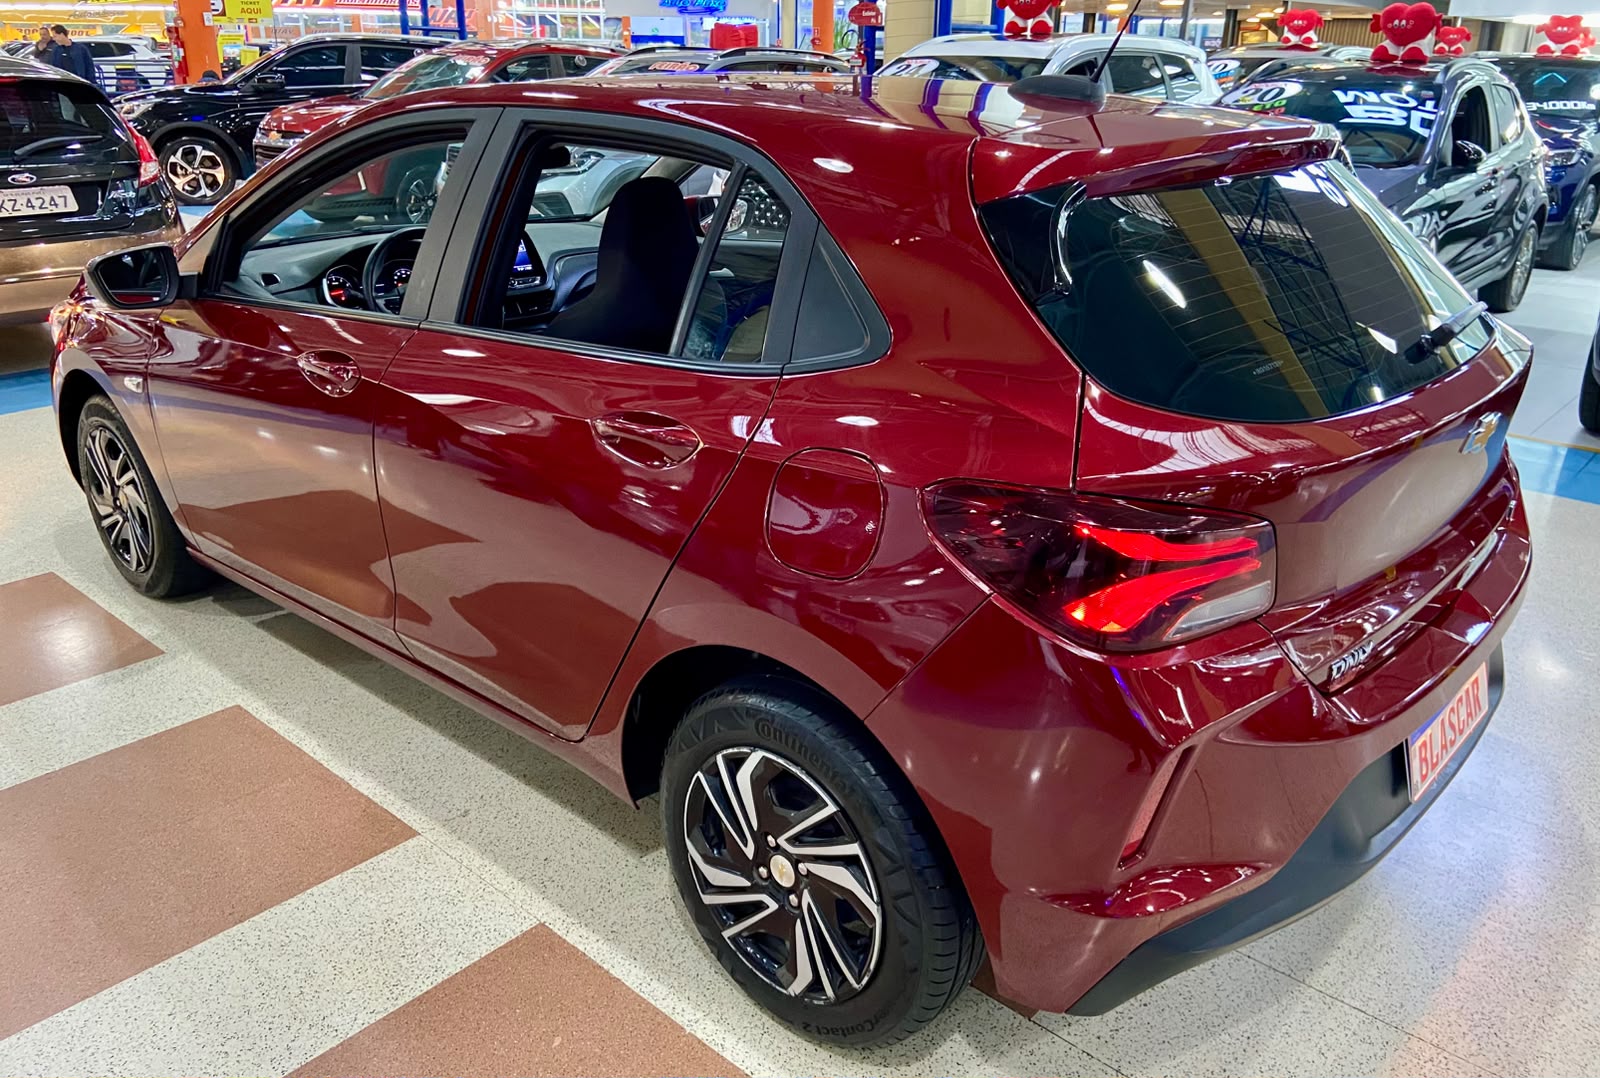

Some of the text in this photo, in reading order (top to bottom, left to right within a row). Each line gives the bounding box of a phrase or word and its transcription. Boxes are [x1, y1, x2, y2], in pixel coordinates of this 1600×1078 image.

[240, 7, 262, 15] AQUI
[1232, 87, 1286, 103] 20
[1419, 676, 1481, 783] BLASCAR
